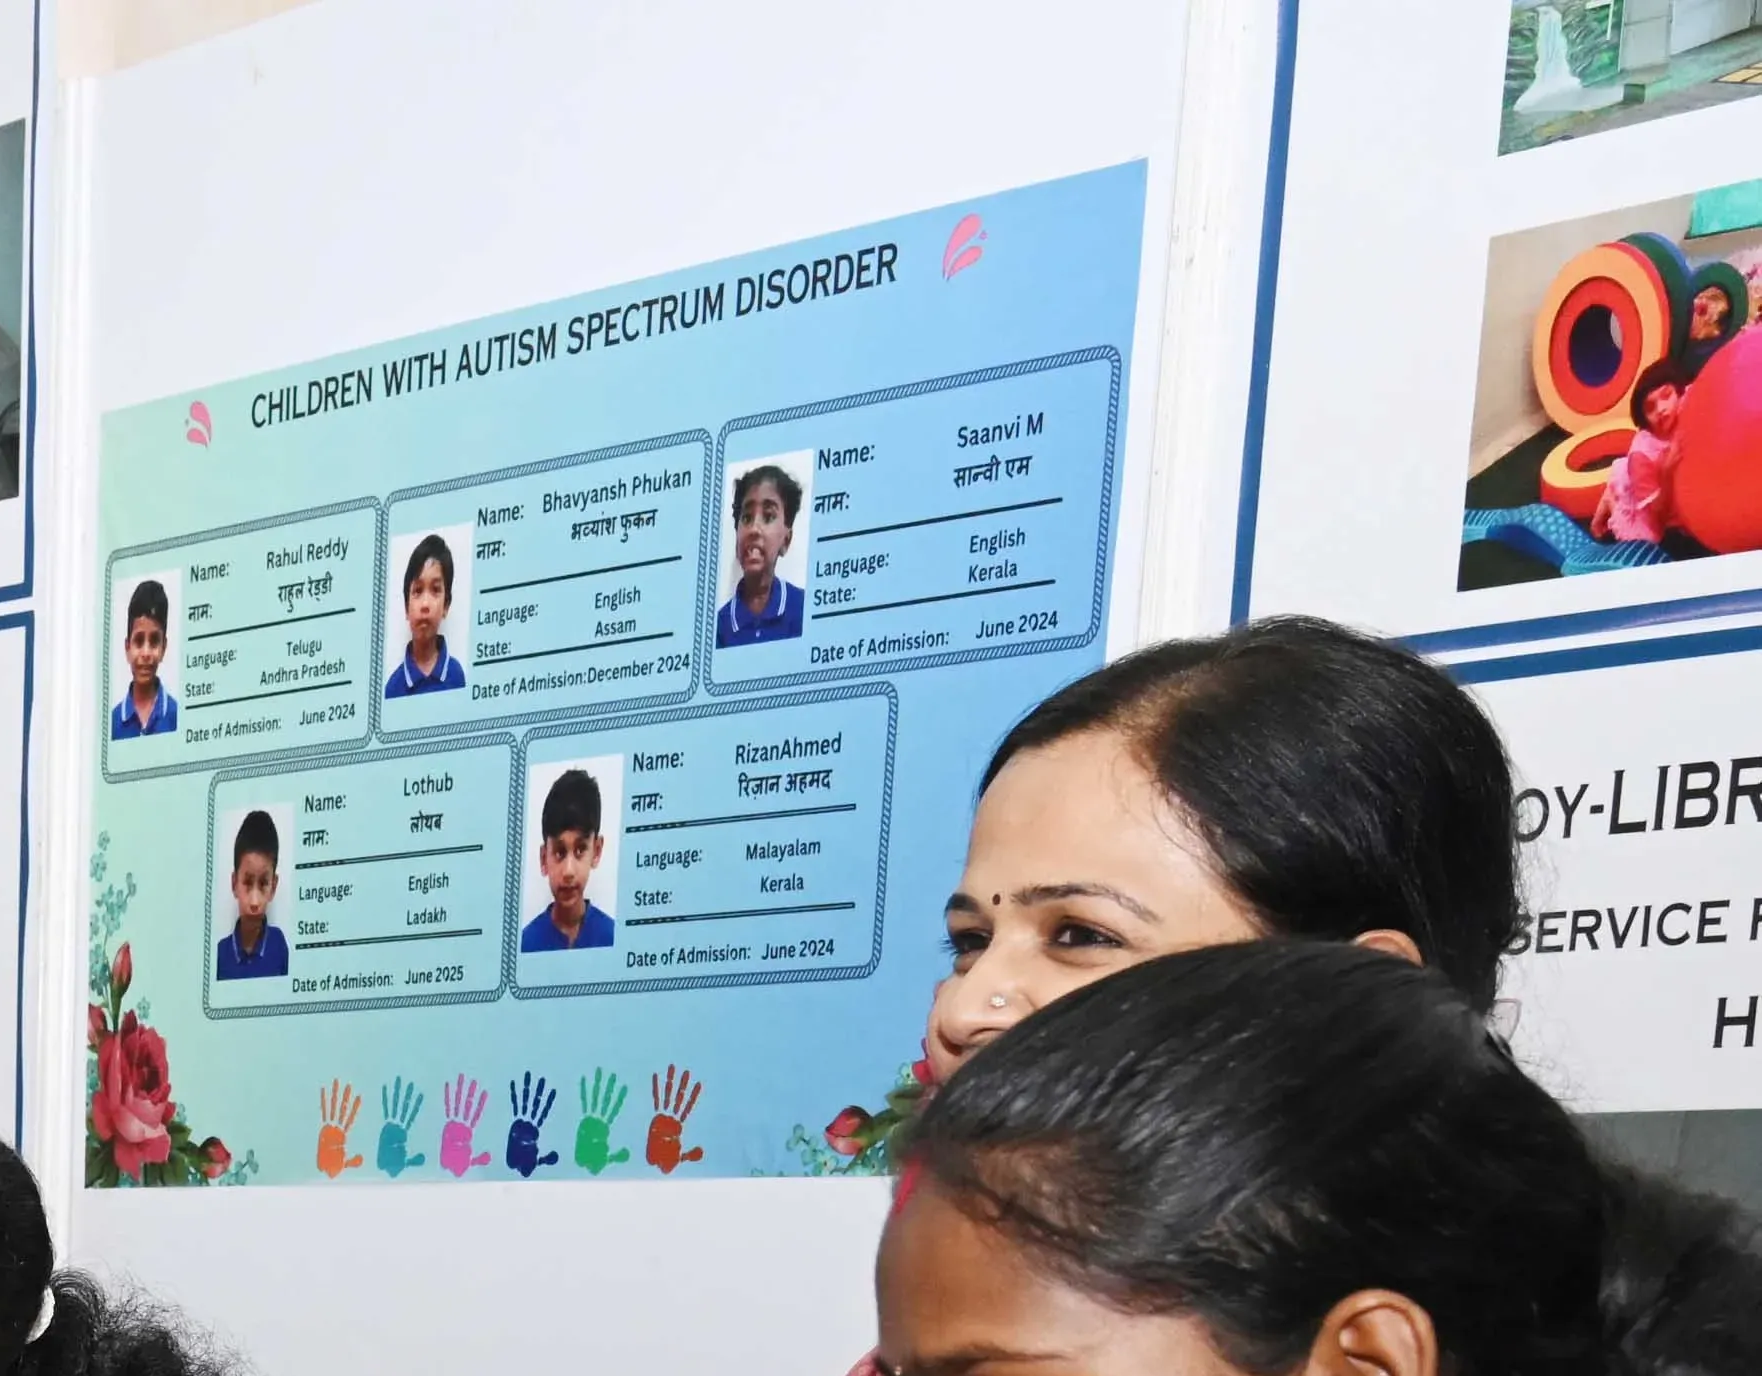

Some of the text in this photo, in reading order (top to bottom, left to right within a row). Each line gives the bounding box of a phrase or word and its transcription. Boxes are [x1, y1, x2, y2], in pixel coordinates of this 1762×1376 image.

[251, 242, 899, 429] CHILDREN WITH AUTISM SPECTRUM DISORDER
[817, 411, 1044, 471] Name: Saanvi M
[953, 454, 1034, 489] सान्वी एम
[476, 468, 692, 528] Name: Bhavyansh Phukan
[189, 536, 349, 583] Name: Rahul Reddy
[815, 526, 1026, 579] Language: English
[813, 558, 1018, 607] State: Kerala
[477, 585, 642, 628] Language: English
[185, 639, 323, 671] Language: Telugu
[475, 618, 637, 659] State: Assam
[810, 609, 1059, 665] Date of Admission: June 2024
[184, 657, 346, 699] State: Andhra Pradesh
[471, 683, 501, 701] Date
[502, 677, 517, 696] of
[656, 652, 691, 675] 2024
[185, 702, 356, 745] Date of Admission: June 2024
[632, 730, 843, 773] Name: RizanAhmed
[304, 771, 454, 814] Name: Lothub
[1513, 757, 1762, 843] OY-LIBR
[635, 838, 822, 872] Language: Malayalam
[298, 871, 450, 904] Language: English
[633, 872, 805, 907] State: Kerala
[297, 906, 448, 936] State: Ladakh
[625, 937, 835, 969] Date of Admission: June 2024
[291, 964, 464, 994] Date of Admission: June 2025
